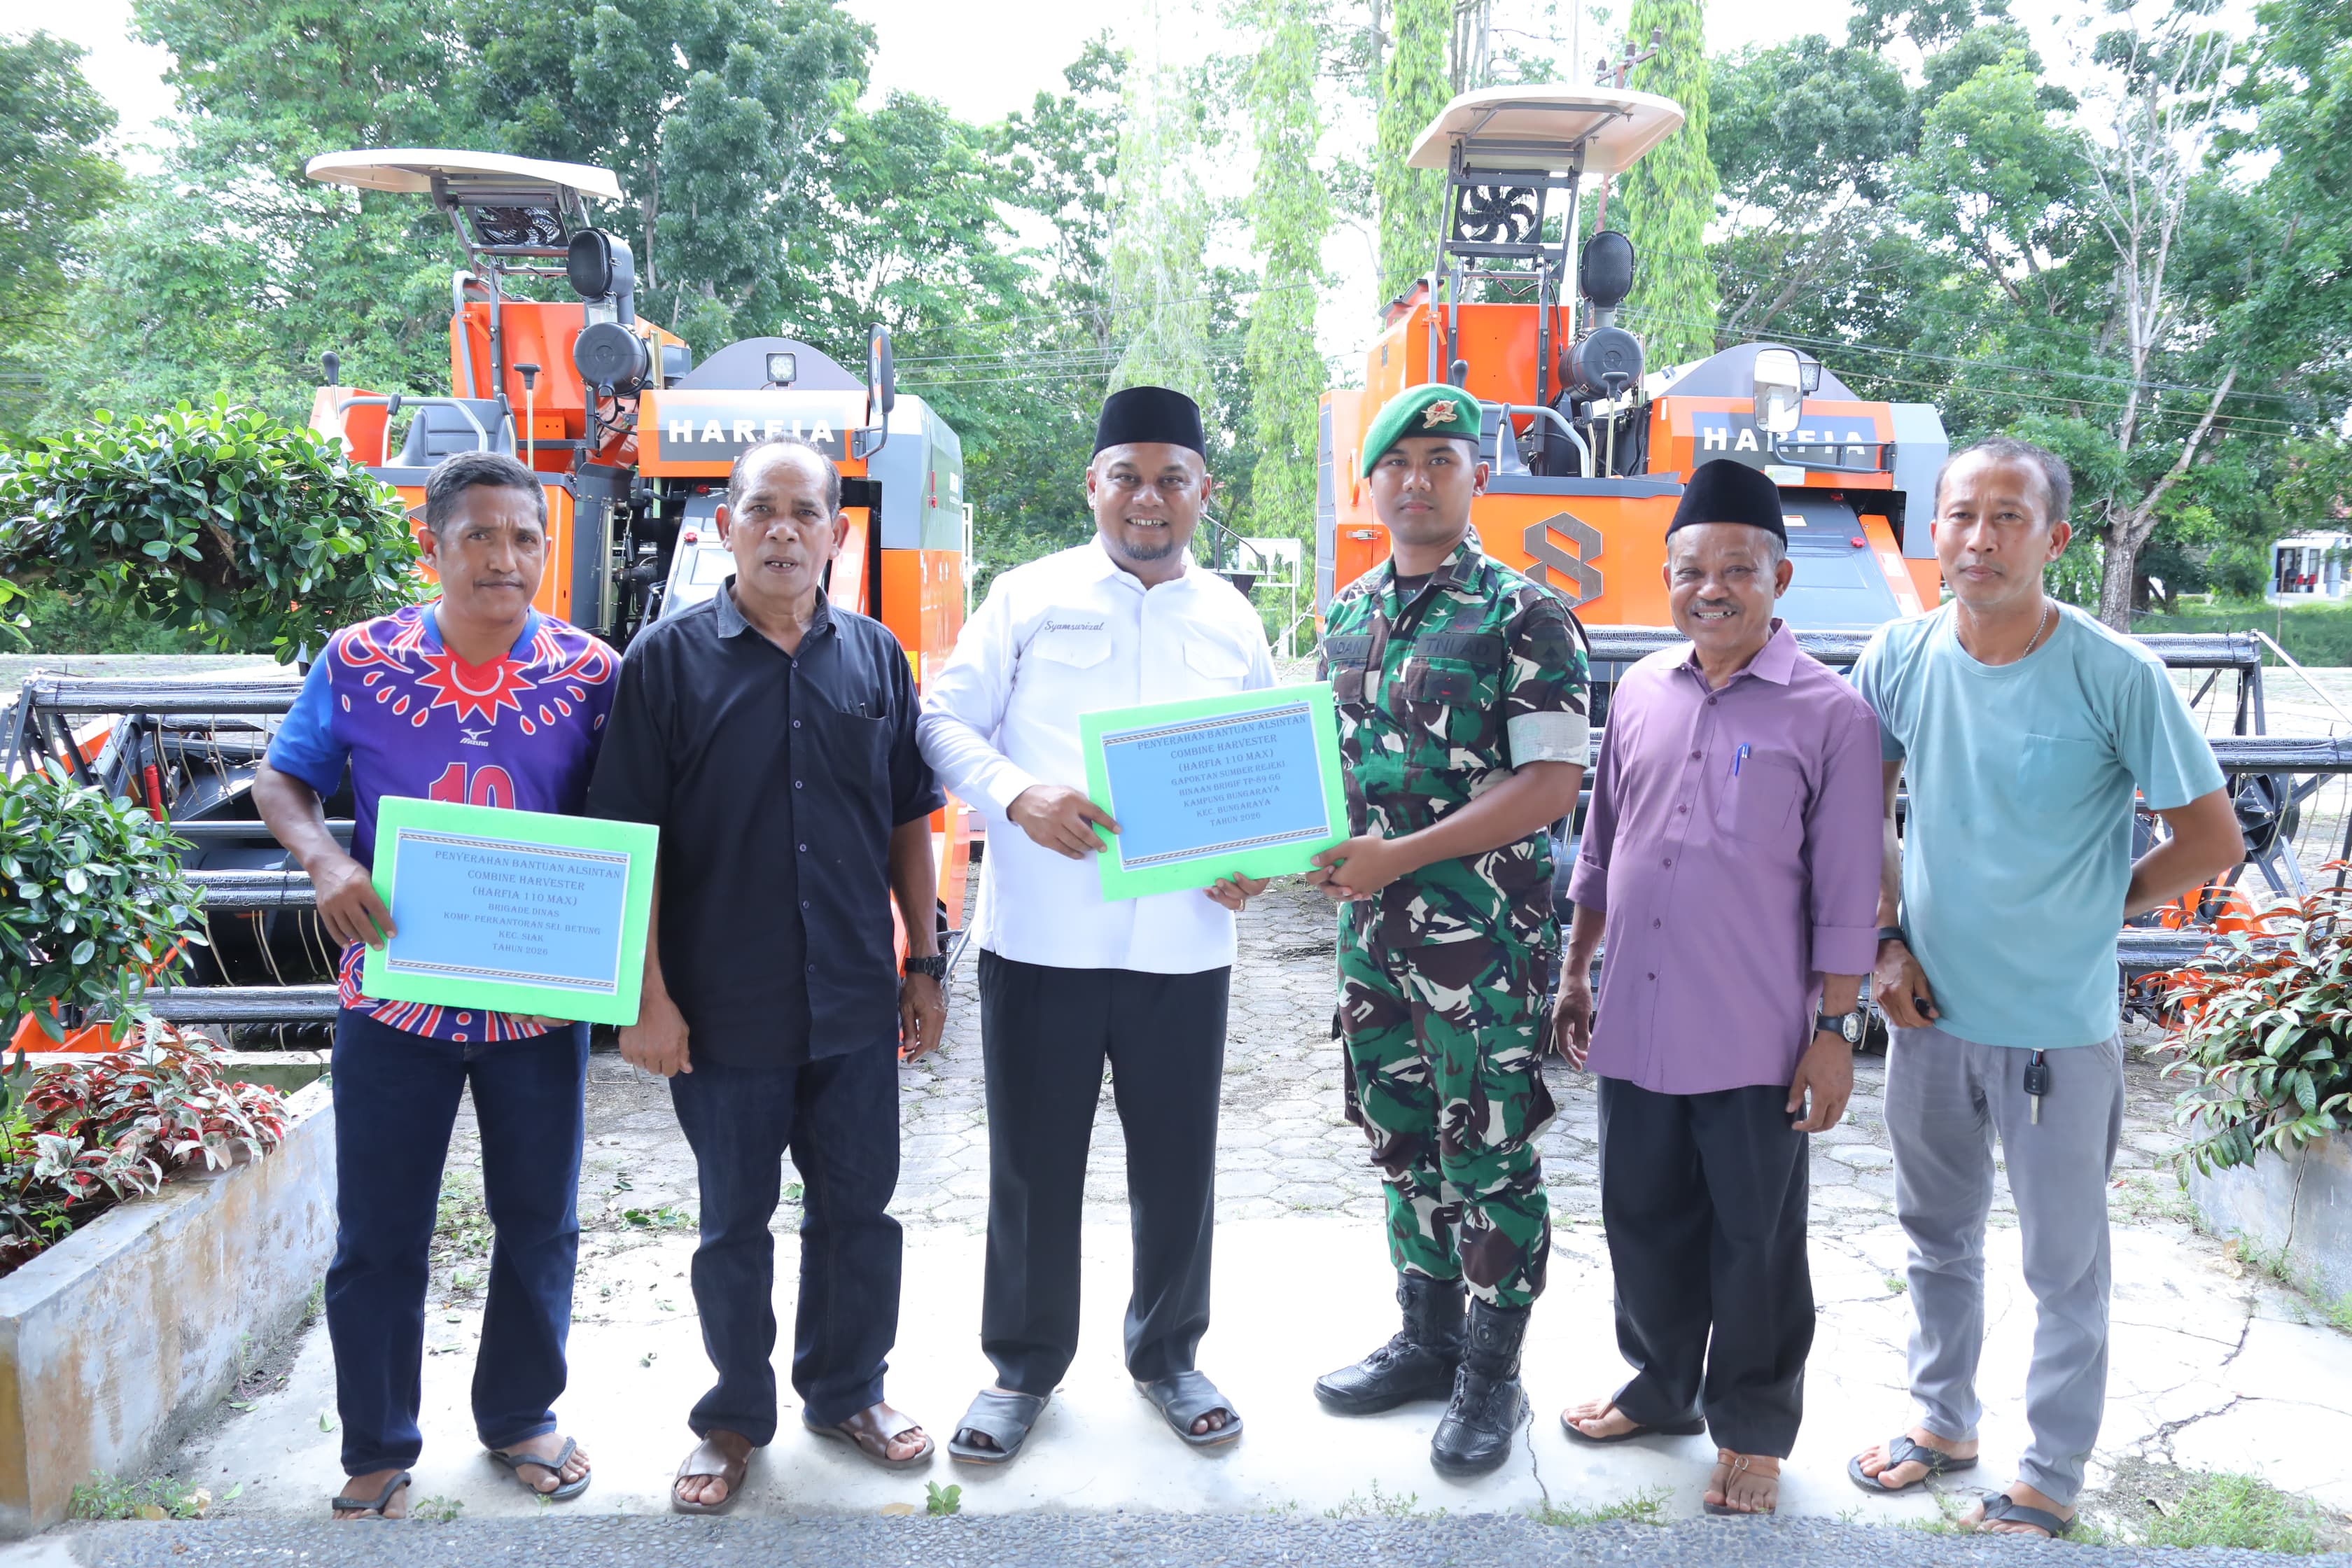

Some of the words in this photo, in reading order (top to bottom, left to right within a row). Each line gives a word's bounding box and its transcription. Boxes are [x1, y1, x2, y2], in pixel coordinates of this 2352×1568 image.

[668, 419, 835, 442] HARFIA
[1703, 427, 1865, 455] HARFIA
[1044, 620, 1105, 633] Syamsurizal
[1426, 638, 1455, 653] TNI
[1138, 732, 1205, 750] PENYERAHAN
[1208, 723, 1254, 738] BANTUAN
[1258, 715, 1306, 730] ALSINTAN
[1170, 744, 1214, 759] COMBINE
[1217, 734, 1278, 751] HARVESTER
[1179, 757, 1222, 773] (HARFIA
[1226, 754, 1243, 764] 110
[1246, 748, 1274, 761] MAX)
[1171, 771, 1217, 786] GAPOKTAN
[1219, 766, 1254, 778] SUMBER
[1255, 760, 1285, 771] REJEKI
[1214, 779, 1241, 790] BRIGIF
[1183, 794, 1224, 807] KAMPUNG
[1226, 785, 1280, 800] BUNGARAYA
[1217, 798, 1271, 813] BUNGARAYA
[1210, 816, 1238, 827] TAHUN
[435, 850, 509, 867] PENYERAHAN
[512, 859, 564, 872] BANTUAN
[567, 866, 620, 879] ALSINTAN
[468, 869, 516, 883] COMBINE
[519, 876, 585, 890] HARVESTER
[472, 886, 519, 900] (HARFIA
[525, 892, 544, 902] 110
[547, 894, 578, 906] MAX)
[488, 903, 530, 914] BRIGADE
[532, 907, 560, 917] DINAS
[443, 911, 471, 921] KOMP.
[475, 915, 543, 929] PERKANTORAN
[565, 924, 601, 935] BETUNG
[493, 943, 523, 953] TAHUN
[522, 933, 544, 942] SIAK
